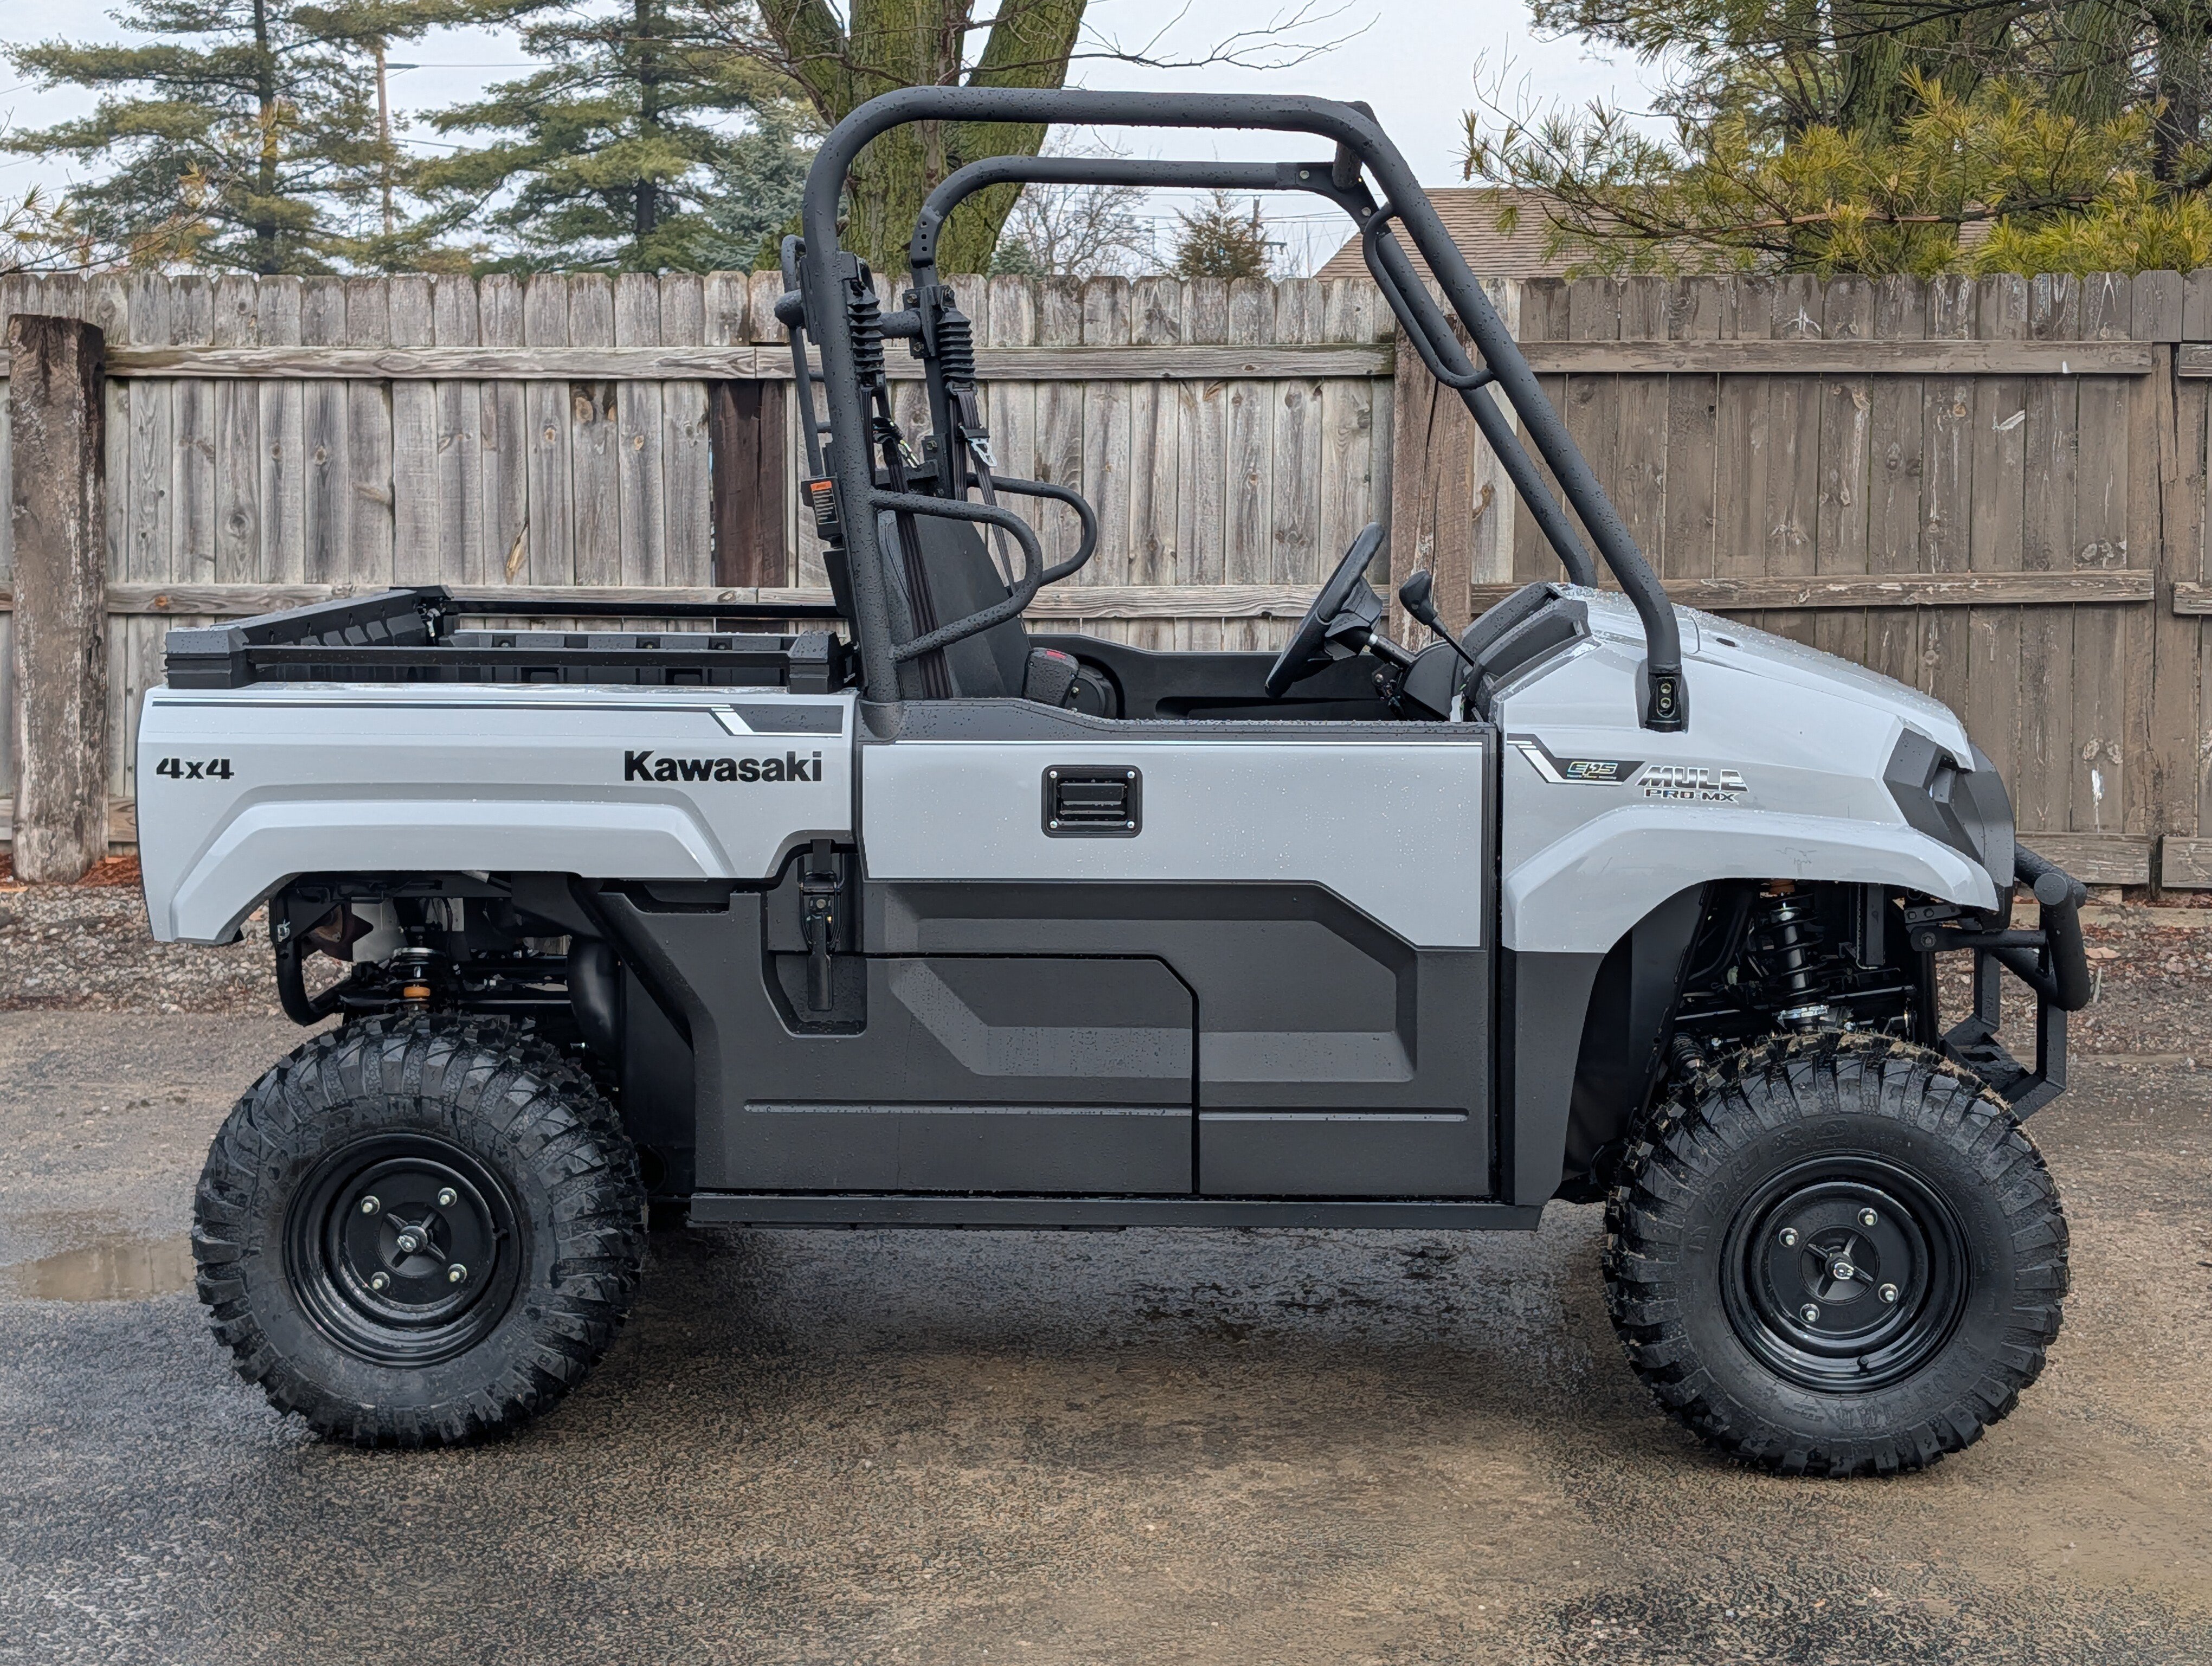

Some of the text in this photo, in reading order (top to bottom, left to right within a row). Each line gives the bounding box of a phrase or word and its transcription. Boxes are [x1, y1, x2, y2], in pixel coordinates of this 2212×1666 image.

[156, 758, 234, 779] 4x4
[625, 751, 822, 782] Kawasaki
[1567, 761, 1618, 776] EPS
[1634, 765, 1750, 793] MULE
[1643, 787, 1740, 805] PRO MX
